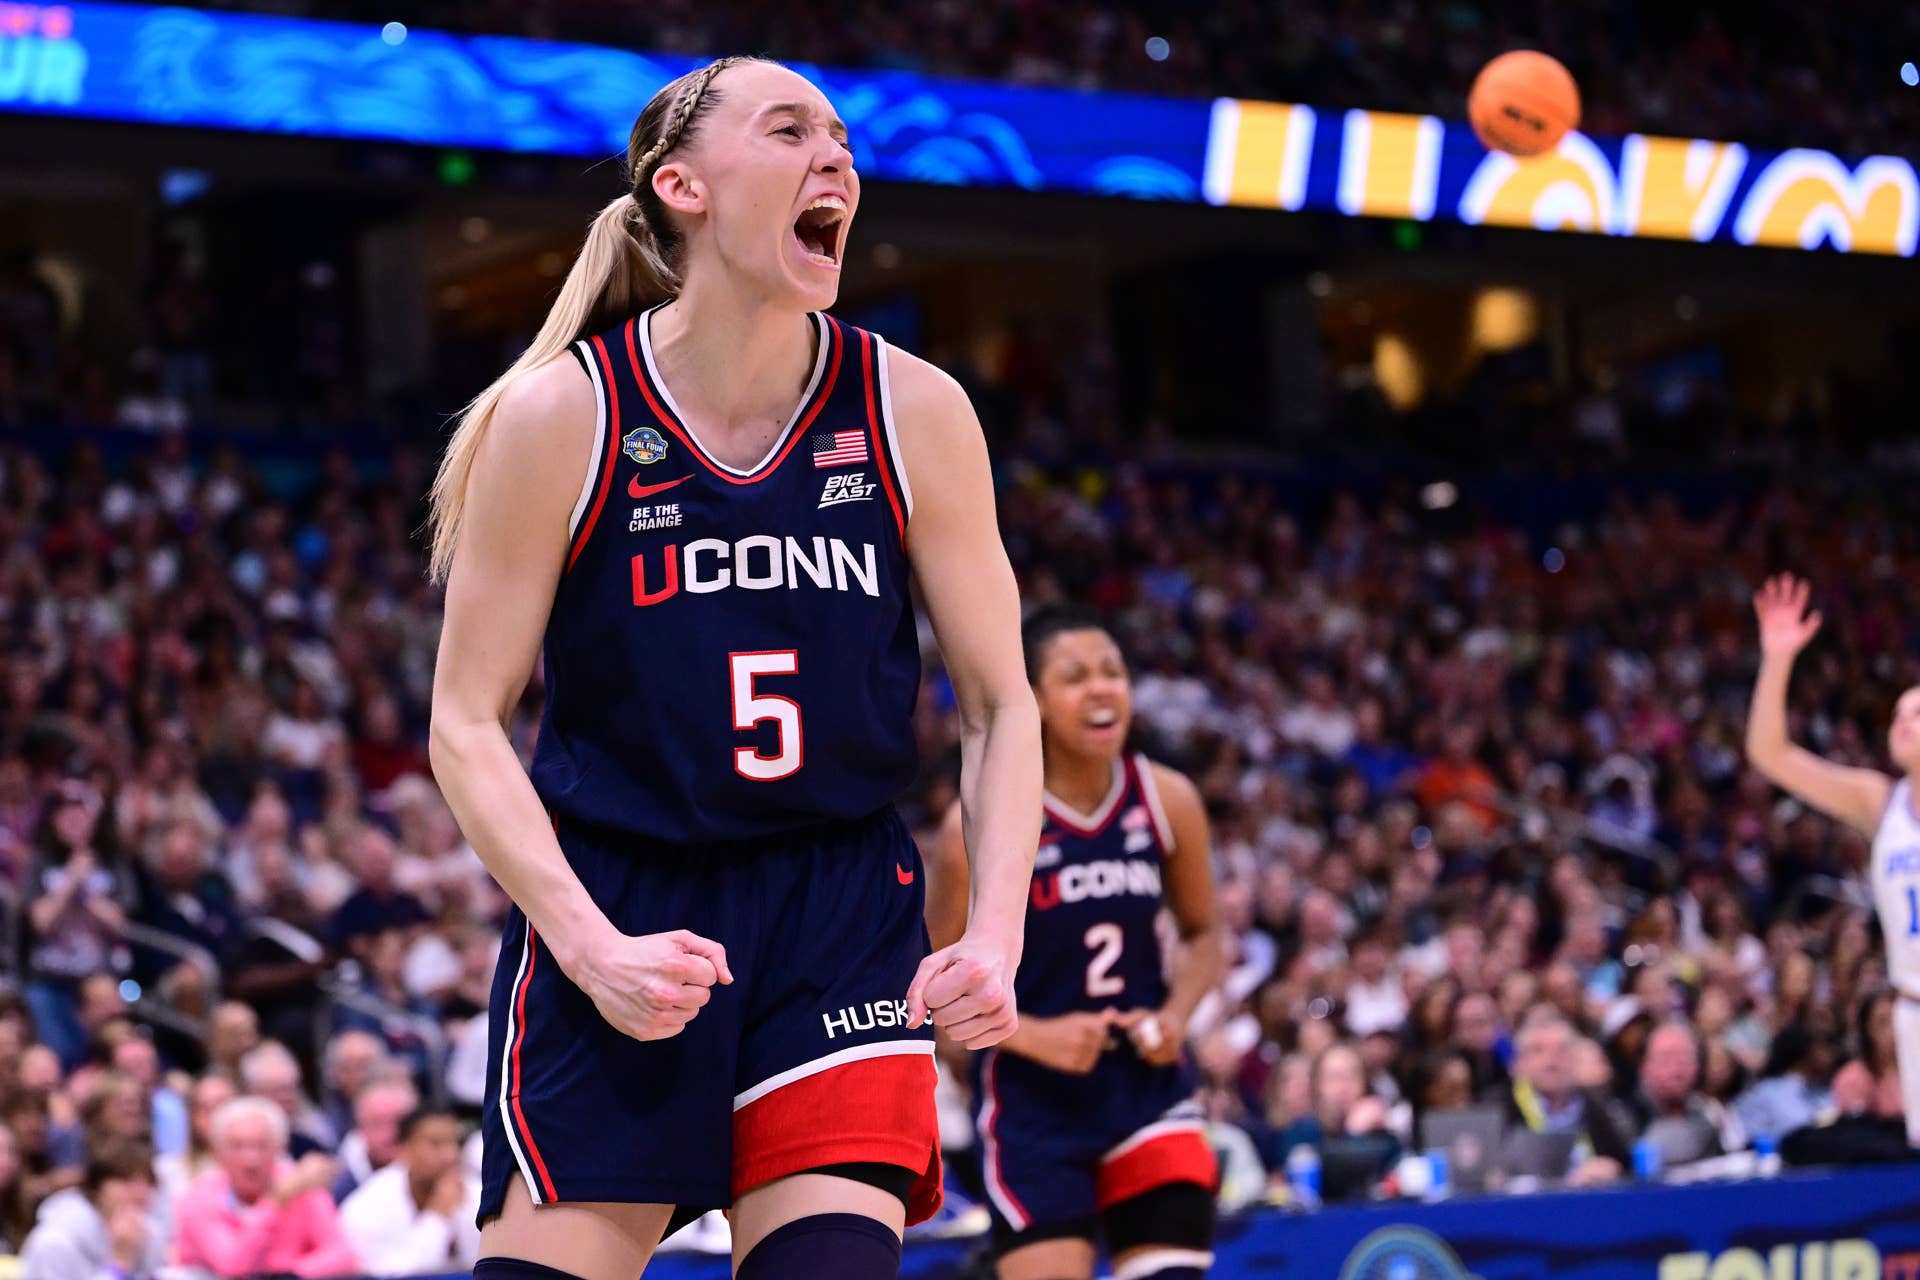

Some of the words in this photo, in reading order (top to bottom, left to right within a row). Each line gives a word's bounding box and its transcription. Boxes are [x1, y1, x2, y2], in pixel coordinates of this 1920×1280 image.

[626, 441, 645, 449] FINAL
[646, 442, 664, 453] FOUR
[824, 472, 865, 489] BIG
[820, 483, 877, 502] EAST
[632, 506, 651, 520] BE
[654, 503, 680, 517] THE
[628, 514, 683, 532] CHANGE
[631, 534, 880, 607] UCONN
[728, 649, 804, 782] 5
[1083, 921, 1126, 998] 2
